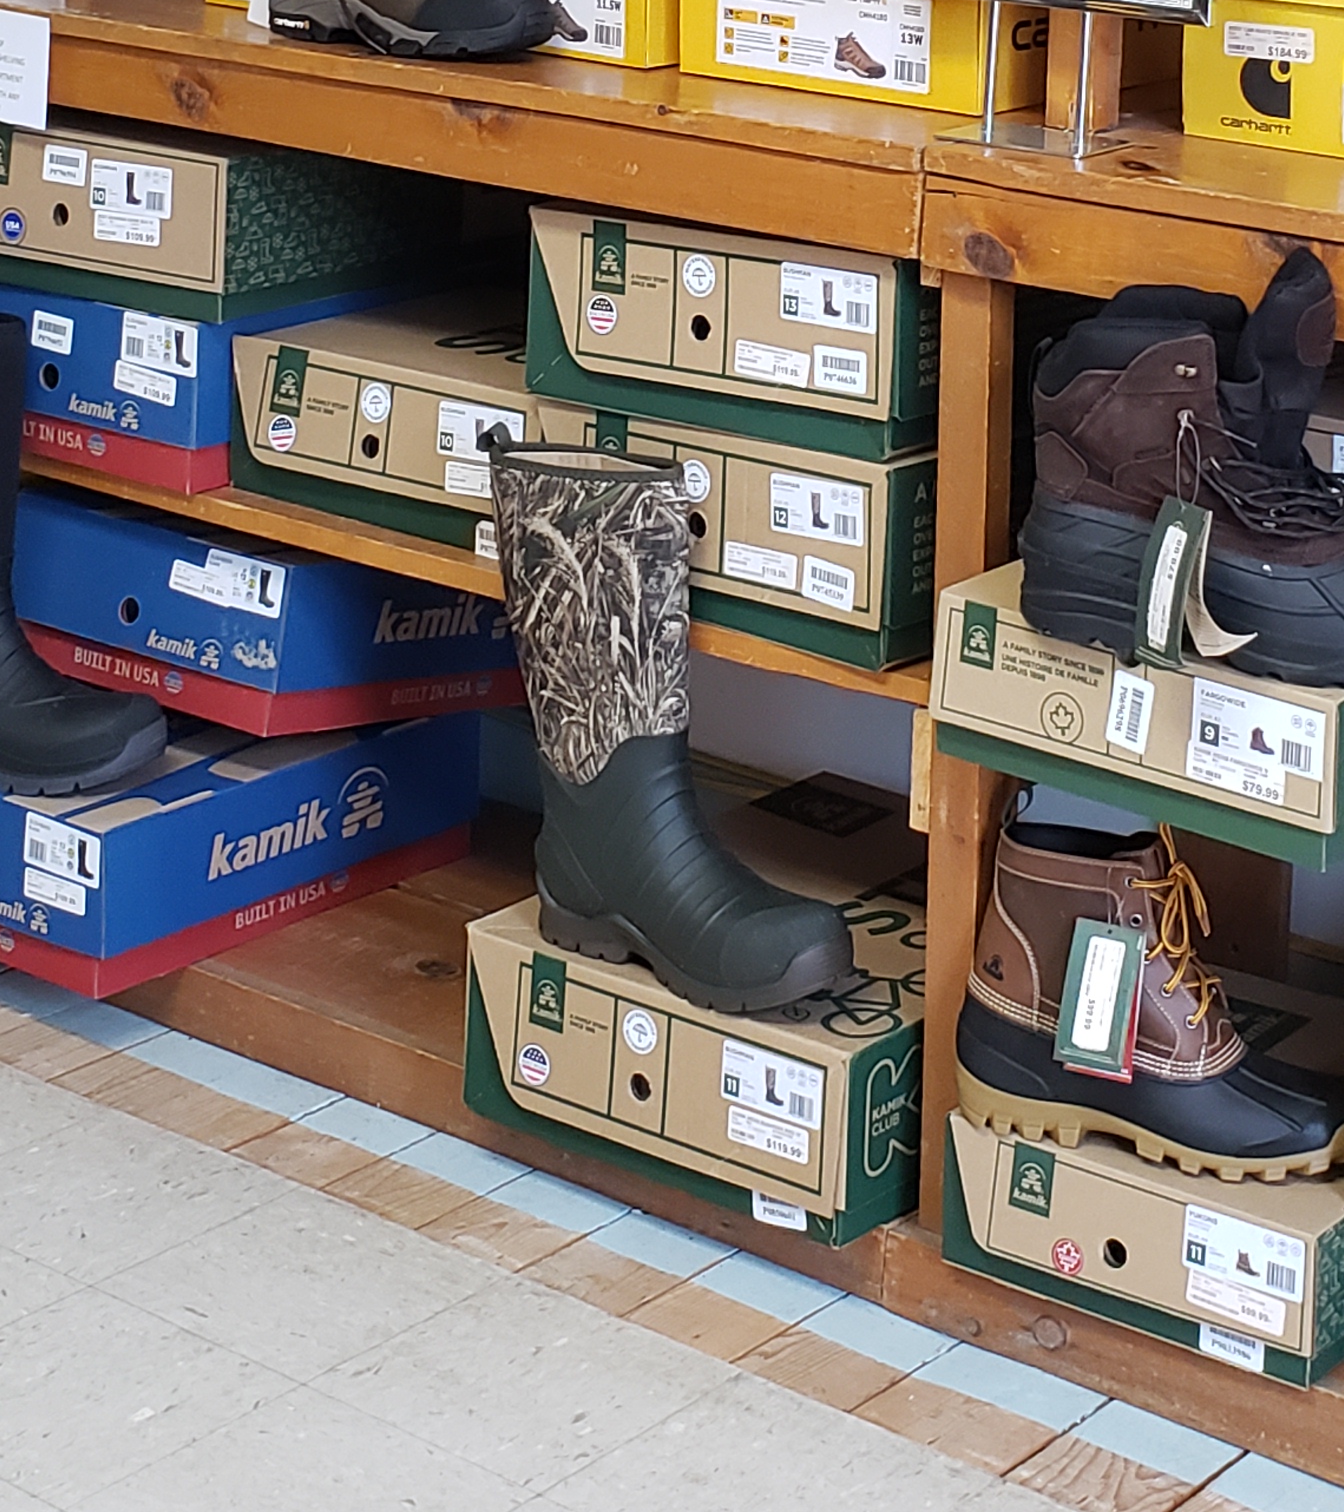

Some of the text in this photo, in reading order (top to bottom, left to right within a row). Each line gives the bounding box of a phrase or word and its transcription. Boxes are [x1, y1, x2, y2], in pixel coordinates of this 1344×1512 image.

[900, 32, 924, 45] 13W
[1268, 46, 1307, 59] $184.99
[68, 393, 116, 420] kamik
[774, 510, 787, 523] 12
[146, 629, 197, 661] kamik
[73, 645, 159, 686] BUILT IN USA
[1200, 689, 1247, 709] FARGOWIDE
[1205, 726, 1214, 740] 9
[1242, 780, 1279, 800] $79.99
[207, 799, 330, 881] kamik
[234, 880, 326, 930] BUILT IN USA
[872, 1095, 906, 1122] KAMIK
[871, 1113, 900, 1137] CLUB
